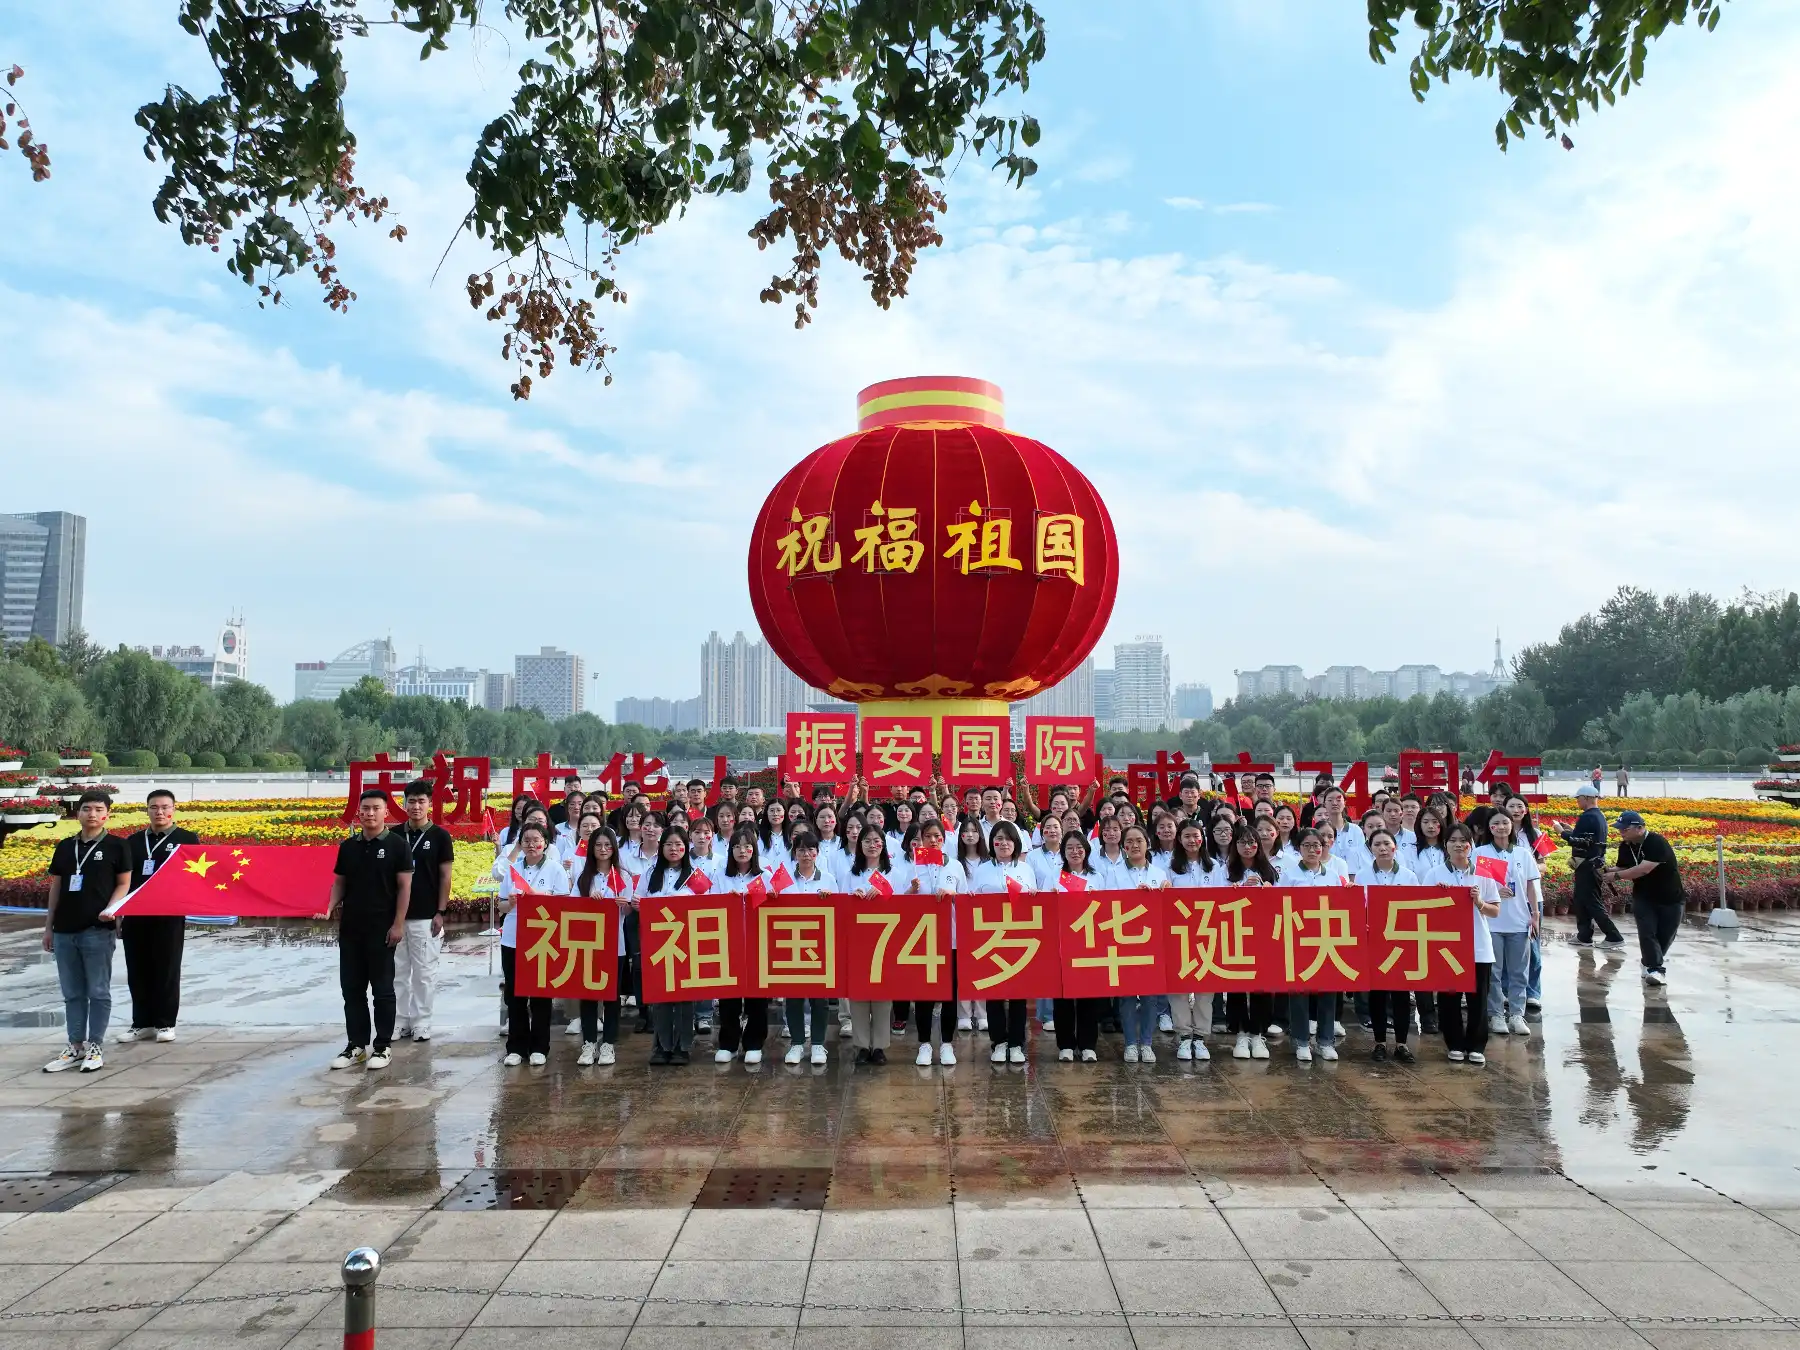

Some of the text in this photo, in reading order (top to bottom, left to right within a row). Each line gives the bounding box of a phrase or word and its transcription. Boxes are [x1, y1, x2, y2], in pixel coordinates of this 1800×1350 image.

[776, 500, 1085, 587] 祝福祖国
[795, 722, 1085, 778] 振安国际
[525, 896, 1465, 991] 祝祖国74岁华诞快乐
